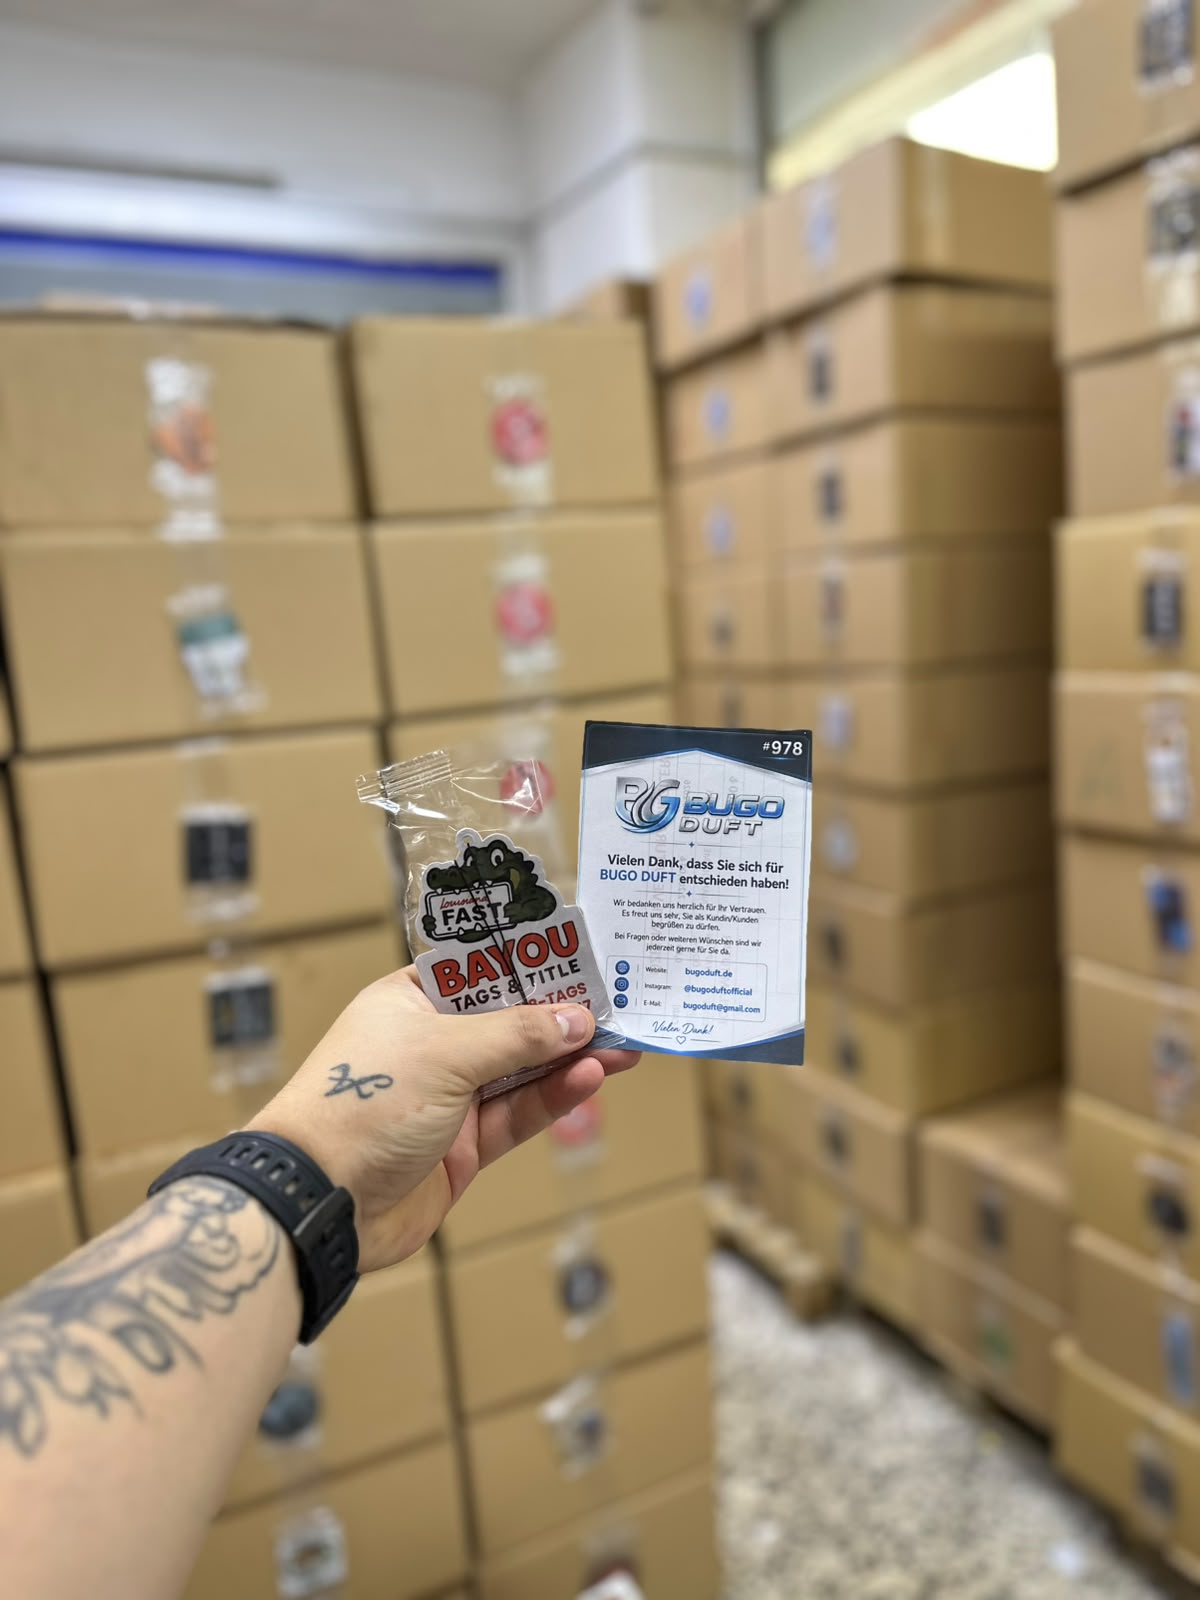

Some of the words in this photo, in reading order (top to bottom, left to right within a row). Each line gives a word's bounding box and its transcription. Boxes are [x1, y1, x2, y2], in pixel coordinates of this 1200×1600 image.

[763, 741, 803, 756] #978
[683, 791, 785, 819] BUGO
[679, 816, 764, 836] DUFT
[607, 854, 645, 867] Vielen
[648, 856, 683, 871] Dank,
[686, 858, 714, 870] dass
[717, 859, 736, 872] Sie
[738, 860, 762, 873] sich
[765, 861, 784, 874] für
[600, 868, 638, 882] BUGO
[641, 870, 677, 884] DUFT
[679, 874, 748, 888] entschieden
[751, 876, 789, 890] haben!
[441, 901, 502, 927] FAST
[613, 898, 626, 907] Wir
[627, 899, 661, 909] bedanken
[676, 902, 705, 911] herzlich
[706, 903, 717, 912] für
[717, 904, 728, 912] Ihr
[729, 904, 767, 914] Vertrauen.
[621, 909, 631, 917] Es
[631, 909, 649, 919] freut
[650, 911, 663, 919] uns
[664, 911, 681, 921] sehr,
[682, 912, 694, 921] Sie
[694, 913, 705, 921] als
[706, 913, 759, 924] Kundin/Kunden
[651, 920, 685, 930] begrüßen
[695, 922, 721, 932] dürfen.
[614, 932, 626, 940] Bei
[626, 932, 650, 942] Fragen
[650, 934, 667, 942] oder
[667, 935, 698, 944] weiteren
[698, 936, 734, 946] Wünschen
[735, 938, 750, 947] sind
[750, 940, 762, 948] wir
[646, 943, 675, 952] jederzeit
[676, 946, 696, 954] gerne
[697, 945, 707, 954] für
[708, 946, 719, 955] Sie
[719, 947, 731, 956] da.
[431, 920, 580, 998] BAYOU
[684, 967, 733, 978] bugoduft.de
[451, 985, 503, 1012] TAGS
[507, 979, 520, 994] &
[525, 958, 581, 987] TITLE
[683, 984, 753, 997] @bugoduftofficial
[682, 1001, 761, 1014] bugoduft@gmail.com
[652, 1020, 681, 1033] Vielen
[682, 1022, 715, 1035] Dank!
